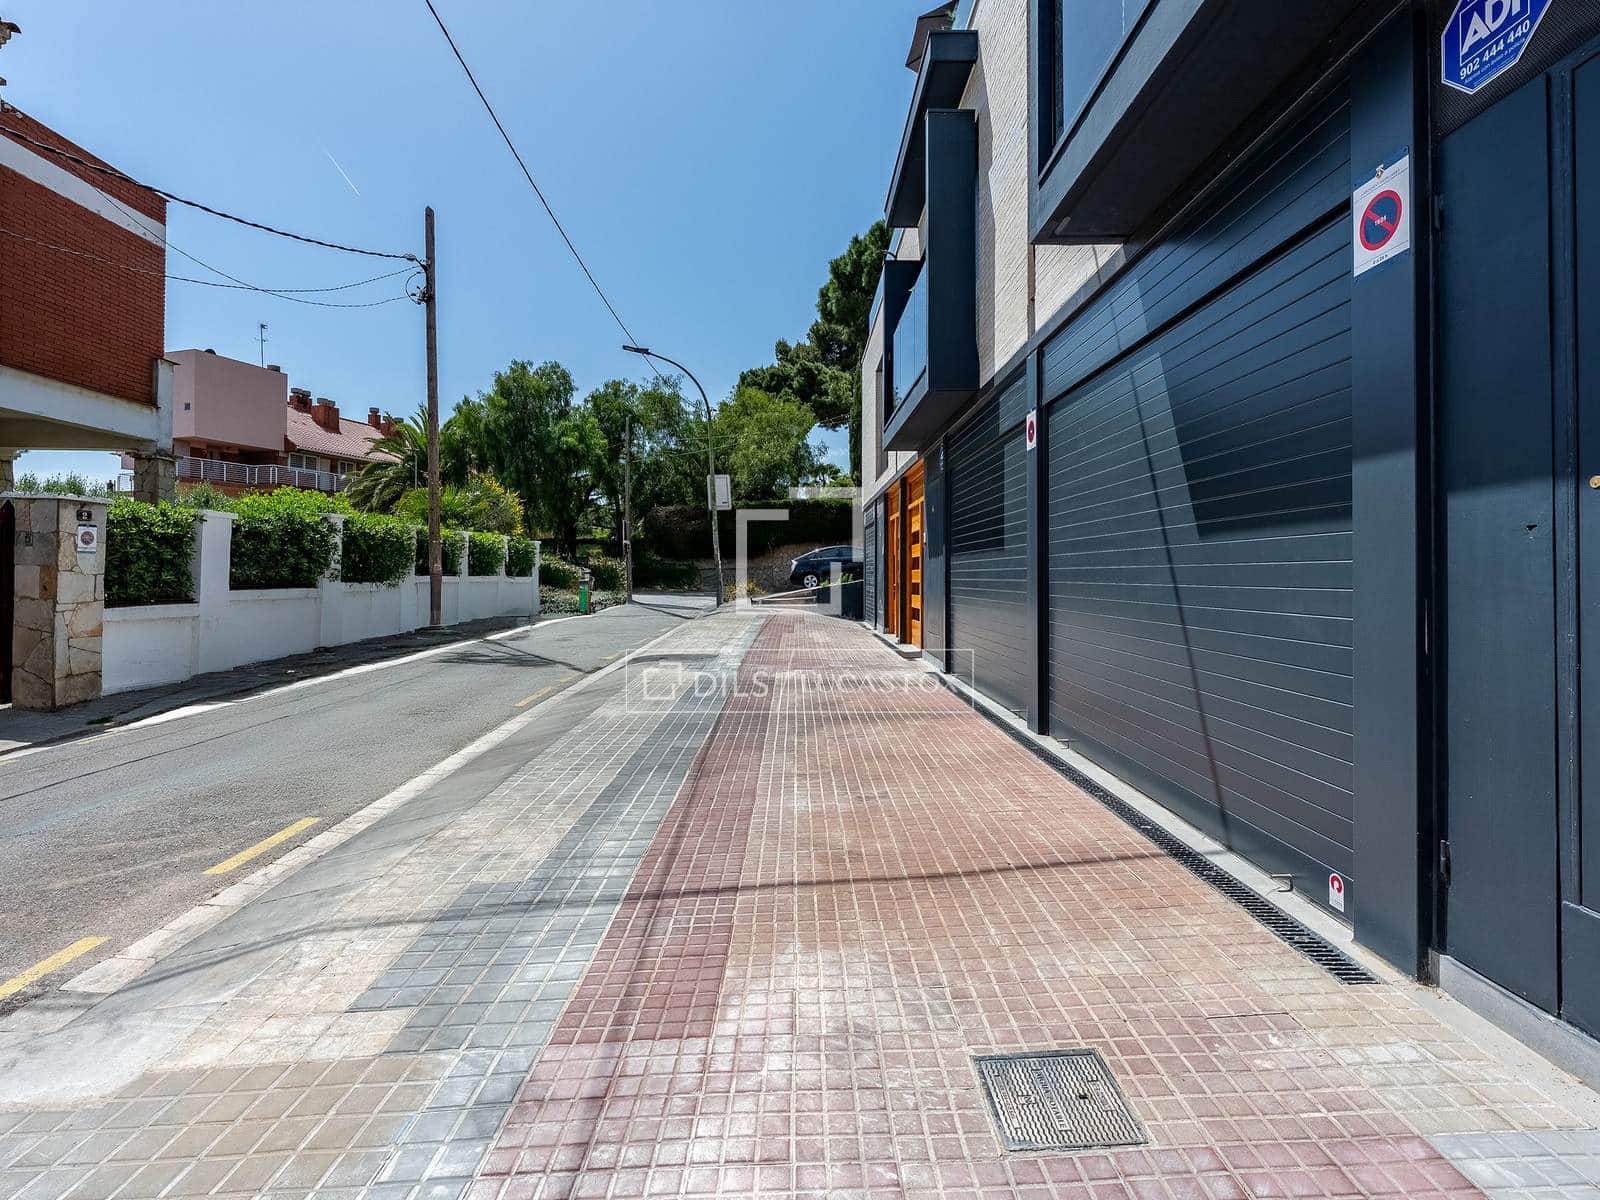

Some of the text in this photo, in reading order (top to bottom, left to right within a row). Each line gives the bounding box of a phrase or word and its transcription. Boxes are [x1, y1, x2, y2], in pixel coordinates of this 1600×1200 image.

[1460, 58, 1480, 79] 902
[1482, 39, 1505, 61] 444
[1507, 20, 1530, 43] 440
